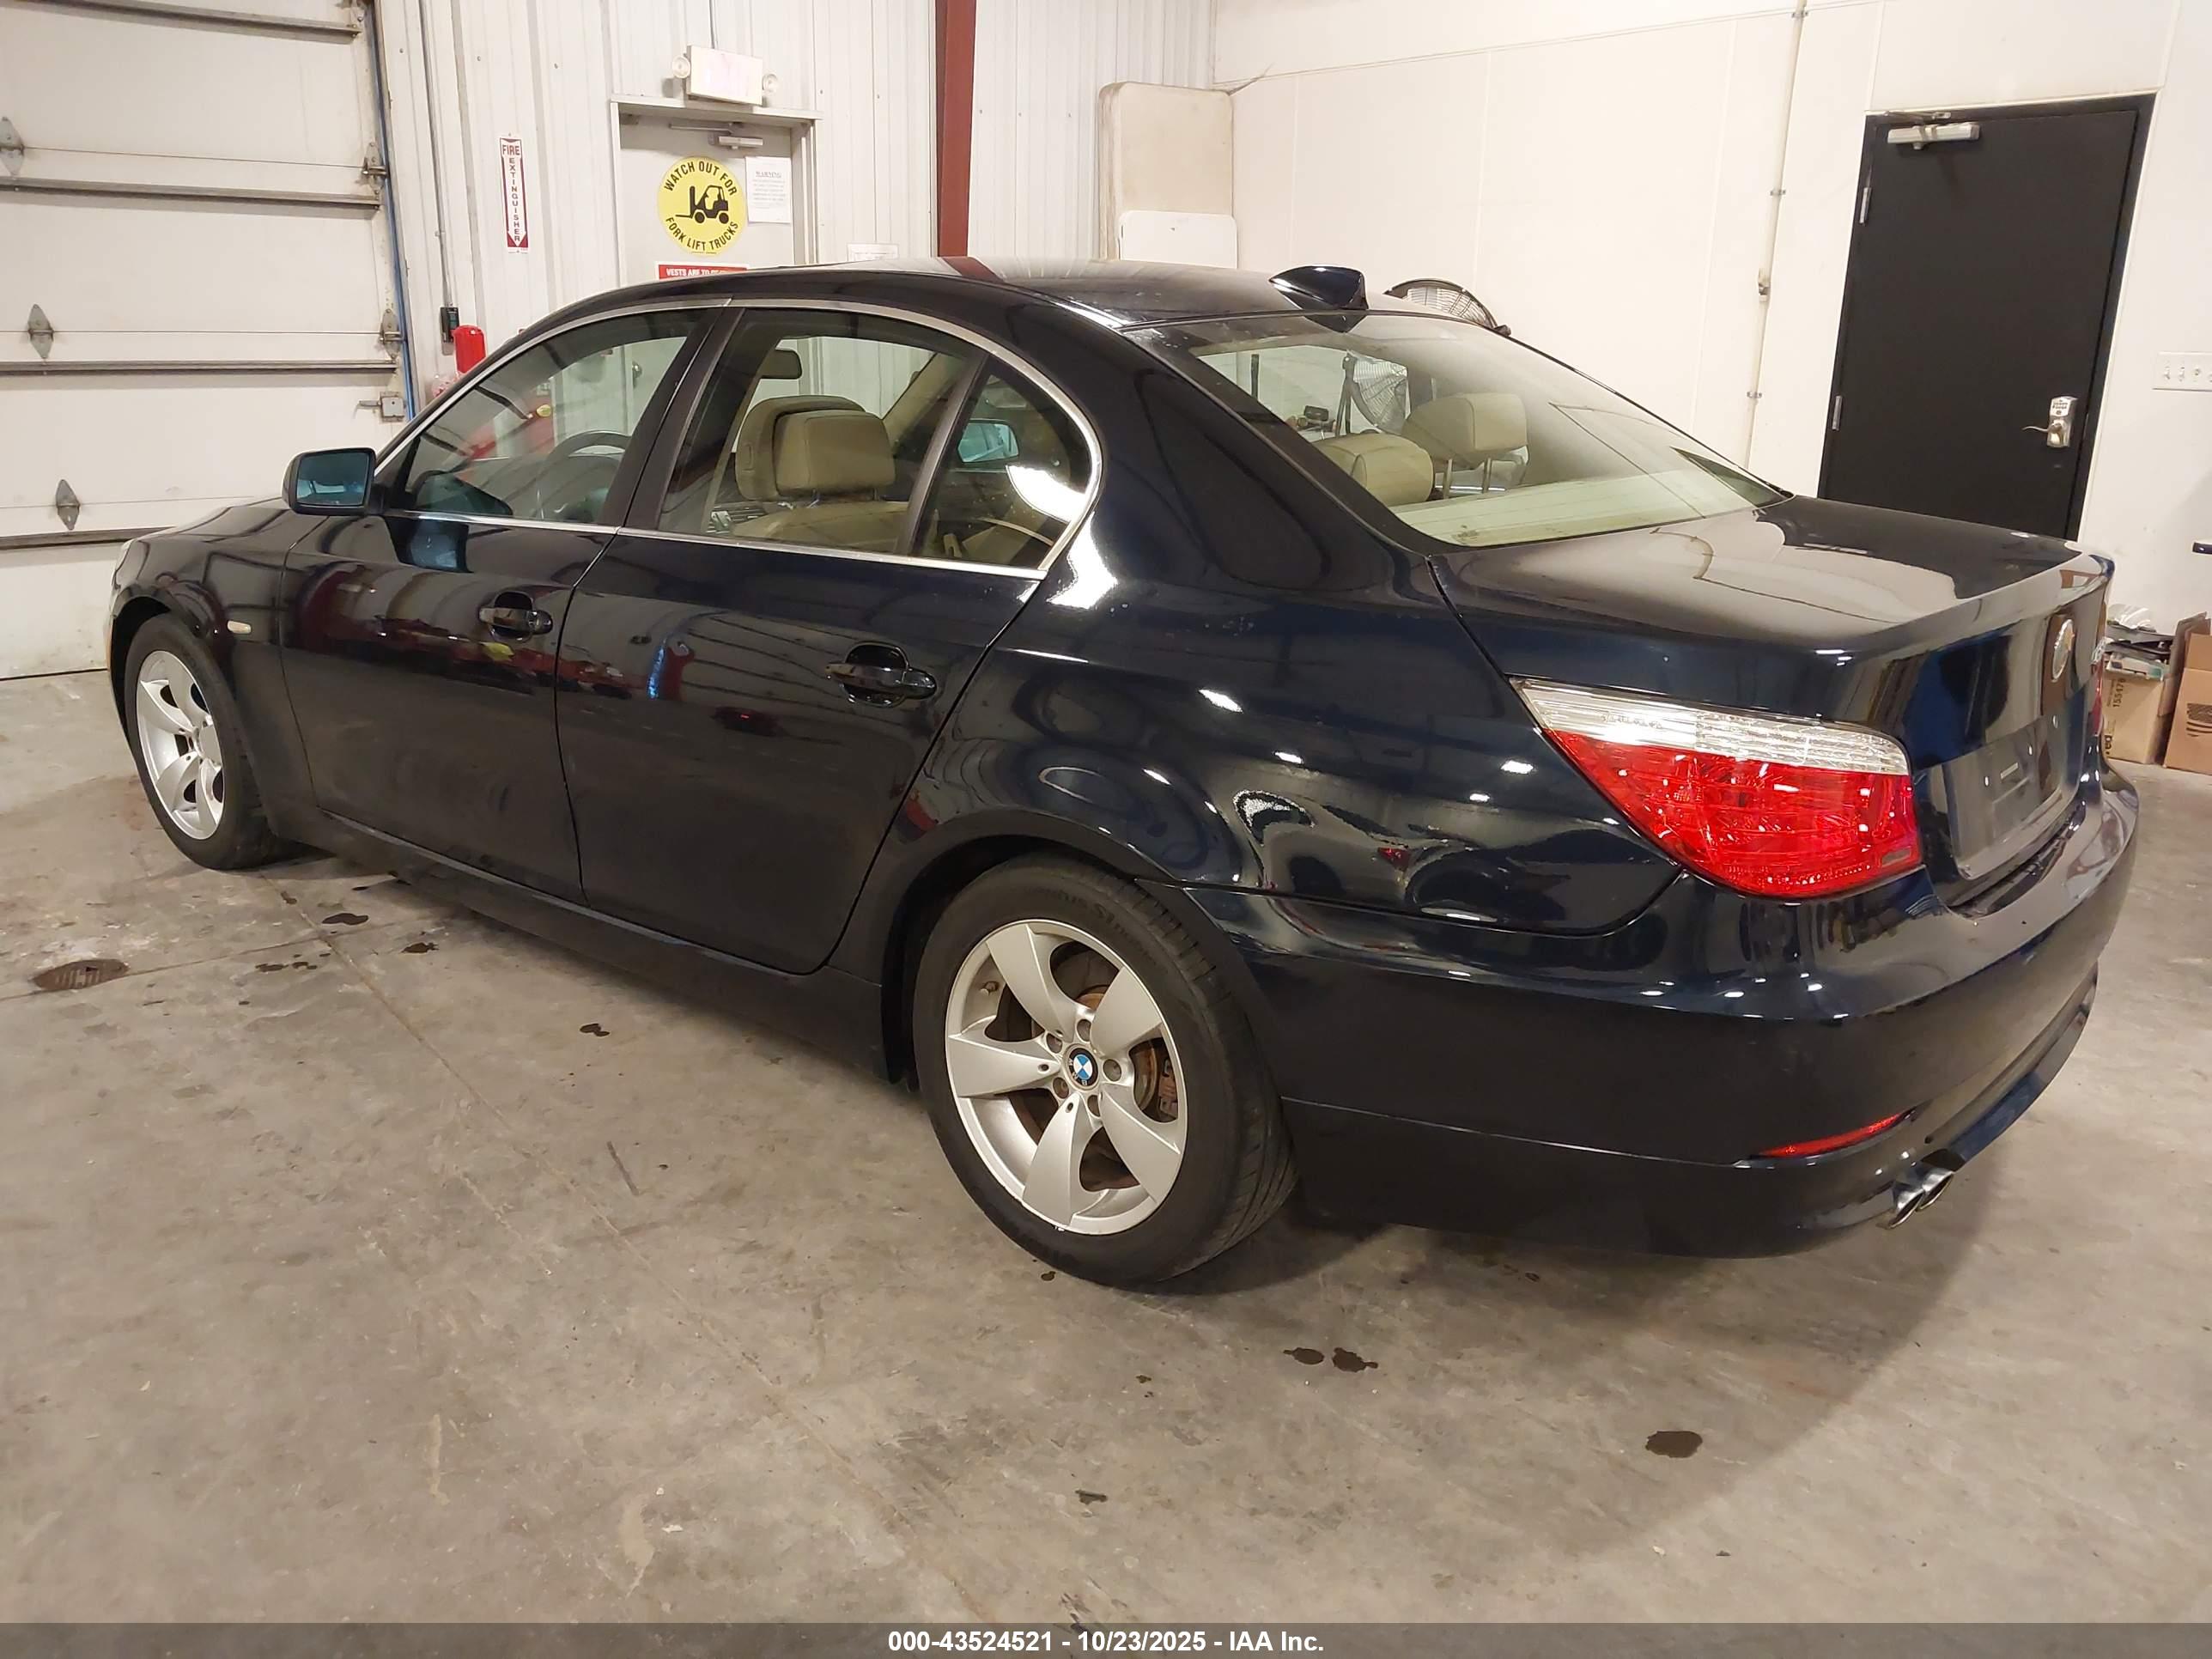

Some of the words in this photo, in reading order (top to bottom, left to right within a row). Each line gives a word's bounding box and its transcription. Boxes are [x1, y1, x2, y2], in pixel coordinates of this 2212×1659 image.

[502, 144, 520, 155] FIRE
[663, 161, 696, 191] WATCH
[698, 161, 720, 177] OUT
[720, 173, 738, 196] FOR
[508, 157, 520, 242] EXTINGUISHER
[665, 216, 687, 244] FORK
[687, 237, 707, 252] LIFT
[708, 221, 739, 251] TRUCKS
[665, 268, 687, 276] VESTS
